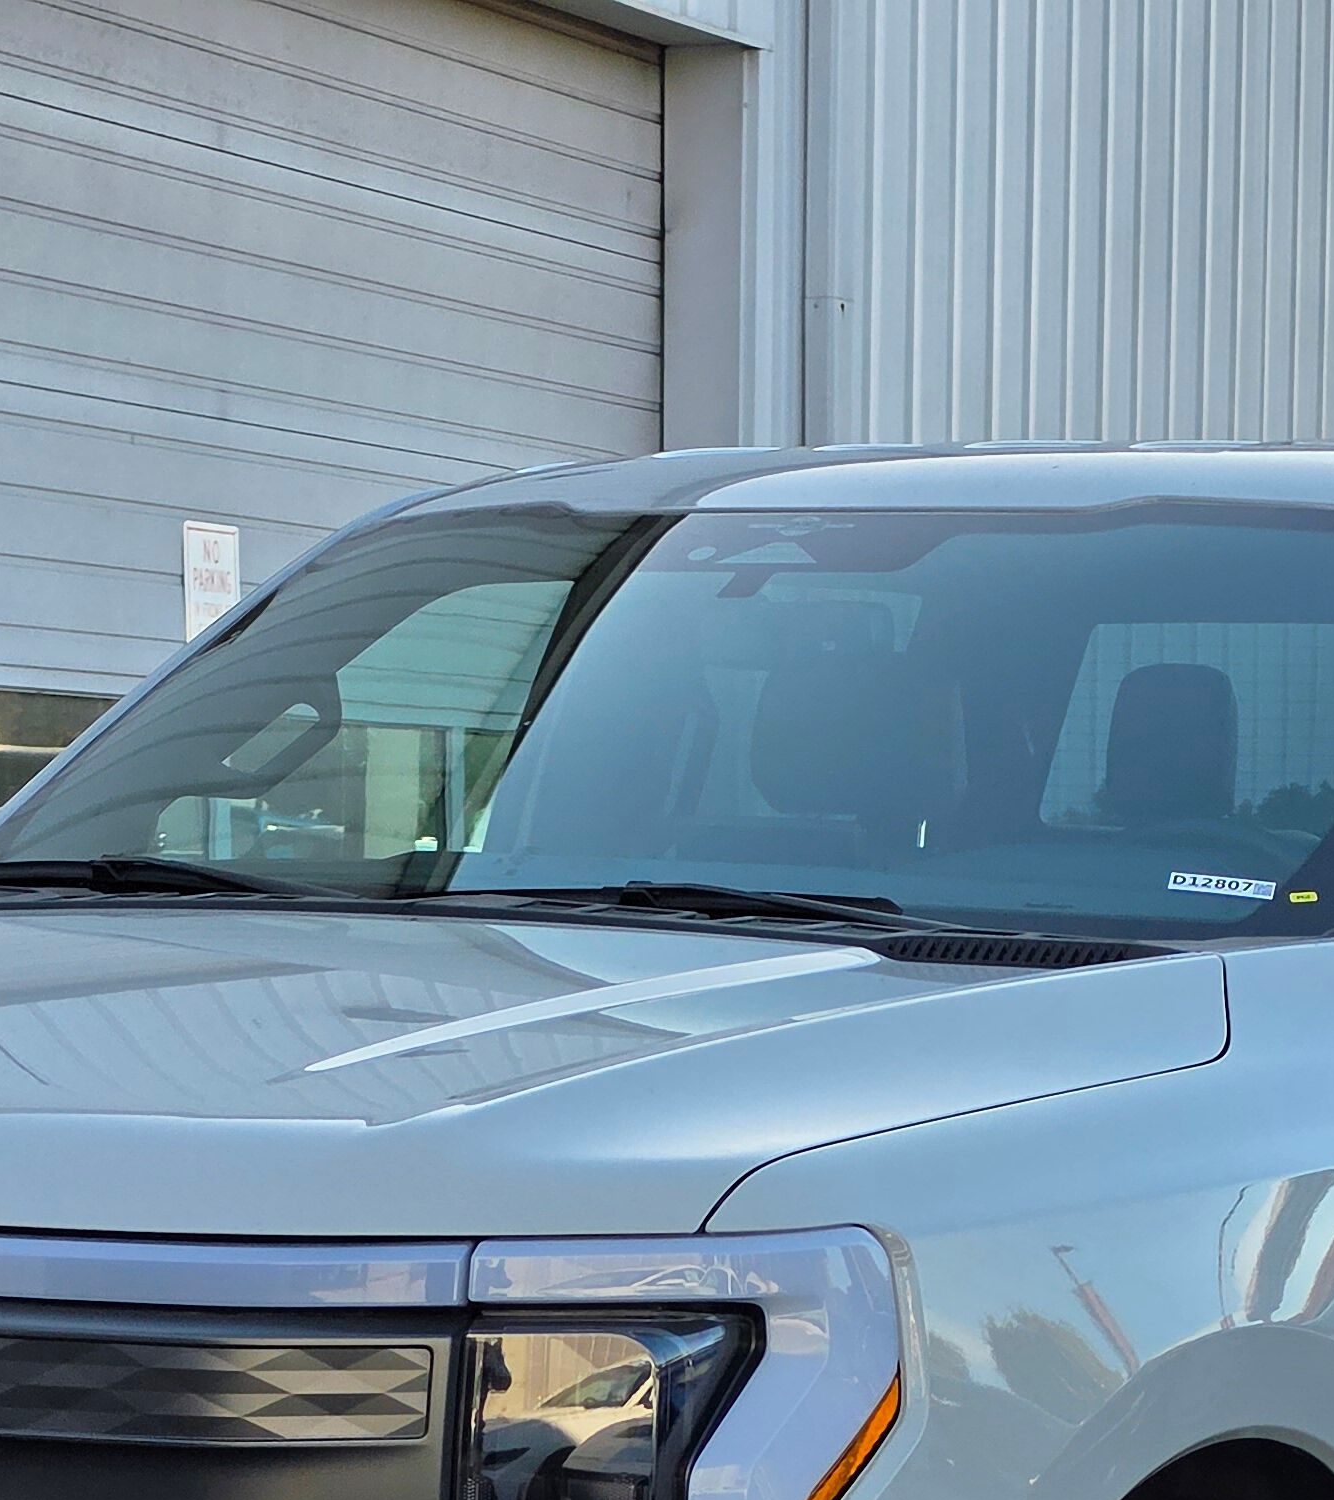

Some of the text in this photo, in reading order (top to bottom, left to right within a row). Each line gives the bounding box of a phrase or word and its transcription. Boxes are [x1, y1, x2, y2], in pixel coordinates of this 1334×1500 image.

[203, 540, 220, 564] NO
[192, 567, 231, 595] PARKING
[1172, 874, 1254, 893] D12807
